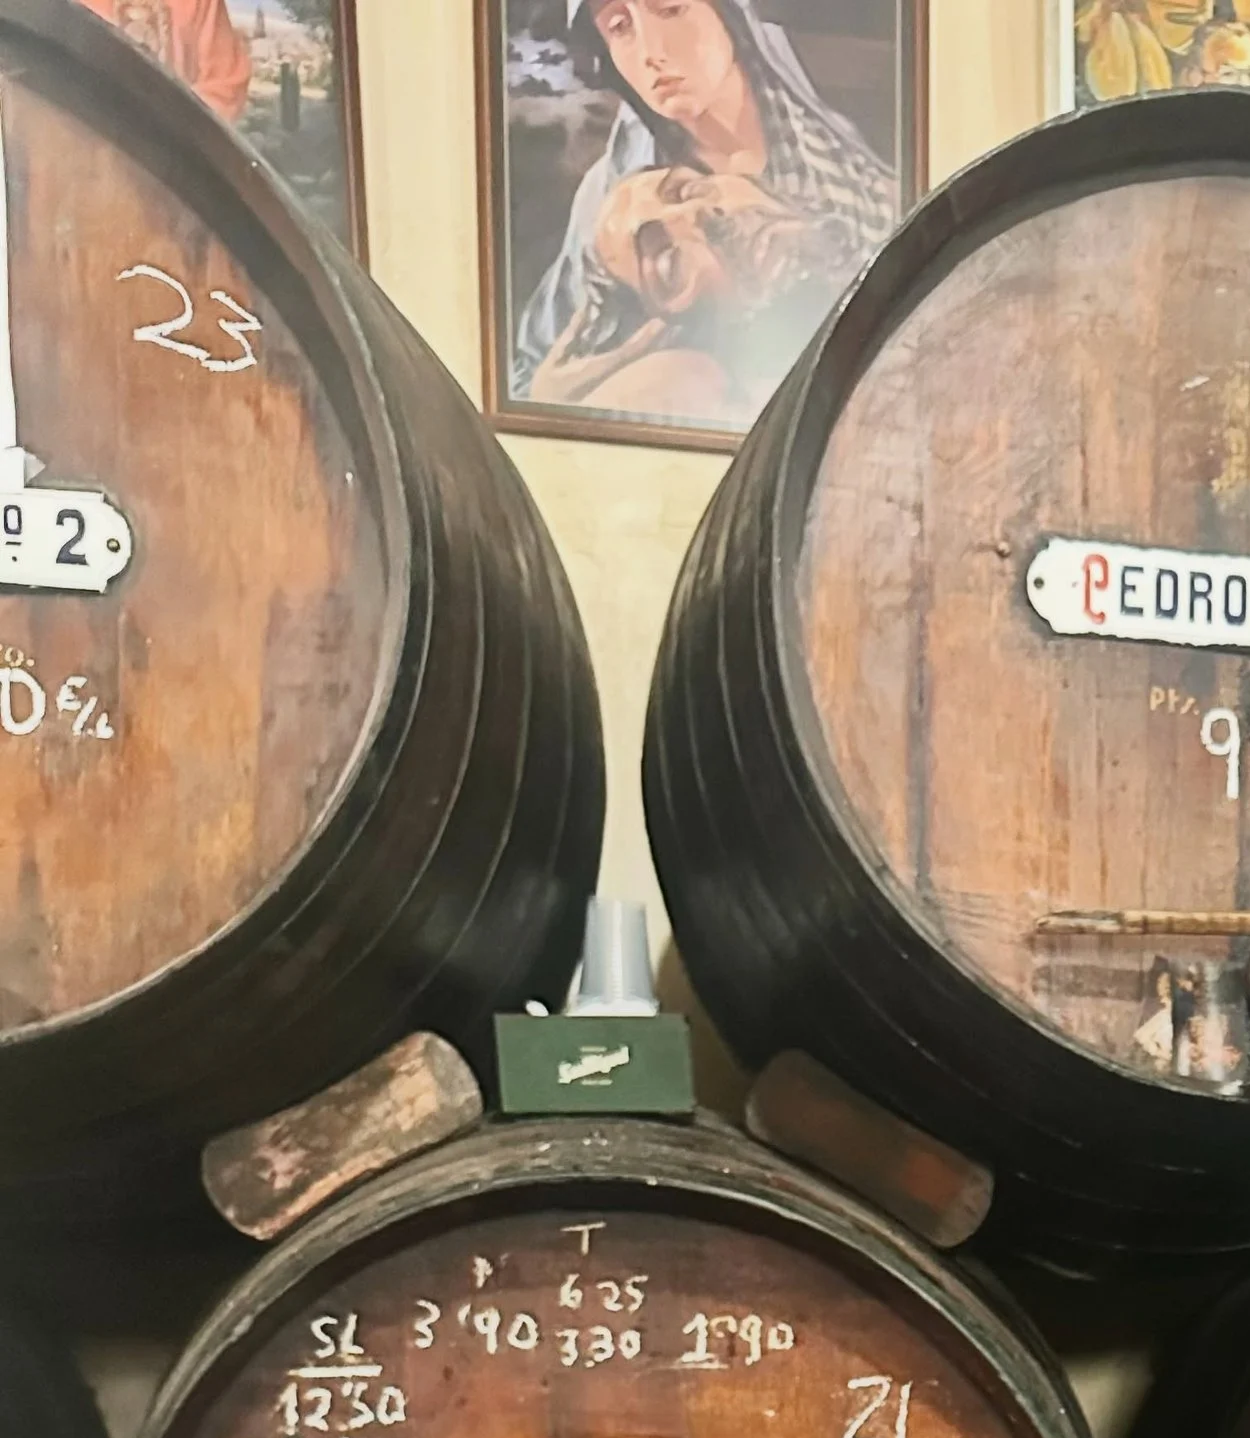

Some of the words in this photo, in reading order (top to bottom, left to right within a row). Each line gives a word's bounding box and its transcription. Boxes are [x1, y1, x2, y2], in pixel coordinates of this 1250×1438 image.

[115, 264, 262, 372] 23
[55, 508, 89, 566] 2
[1081, 554, 1249, 625] PEDRO
